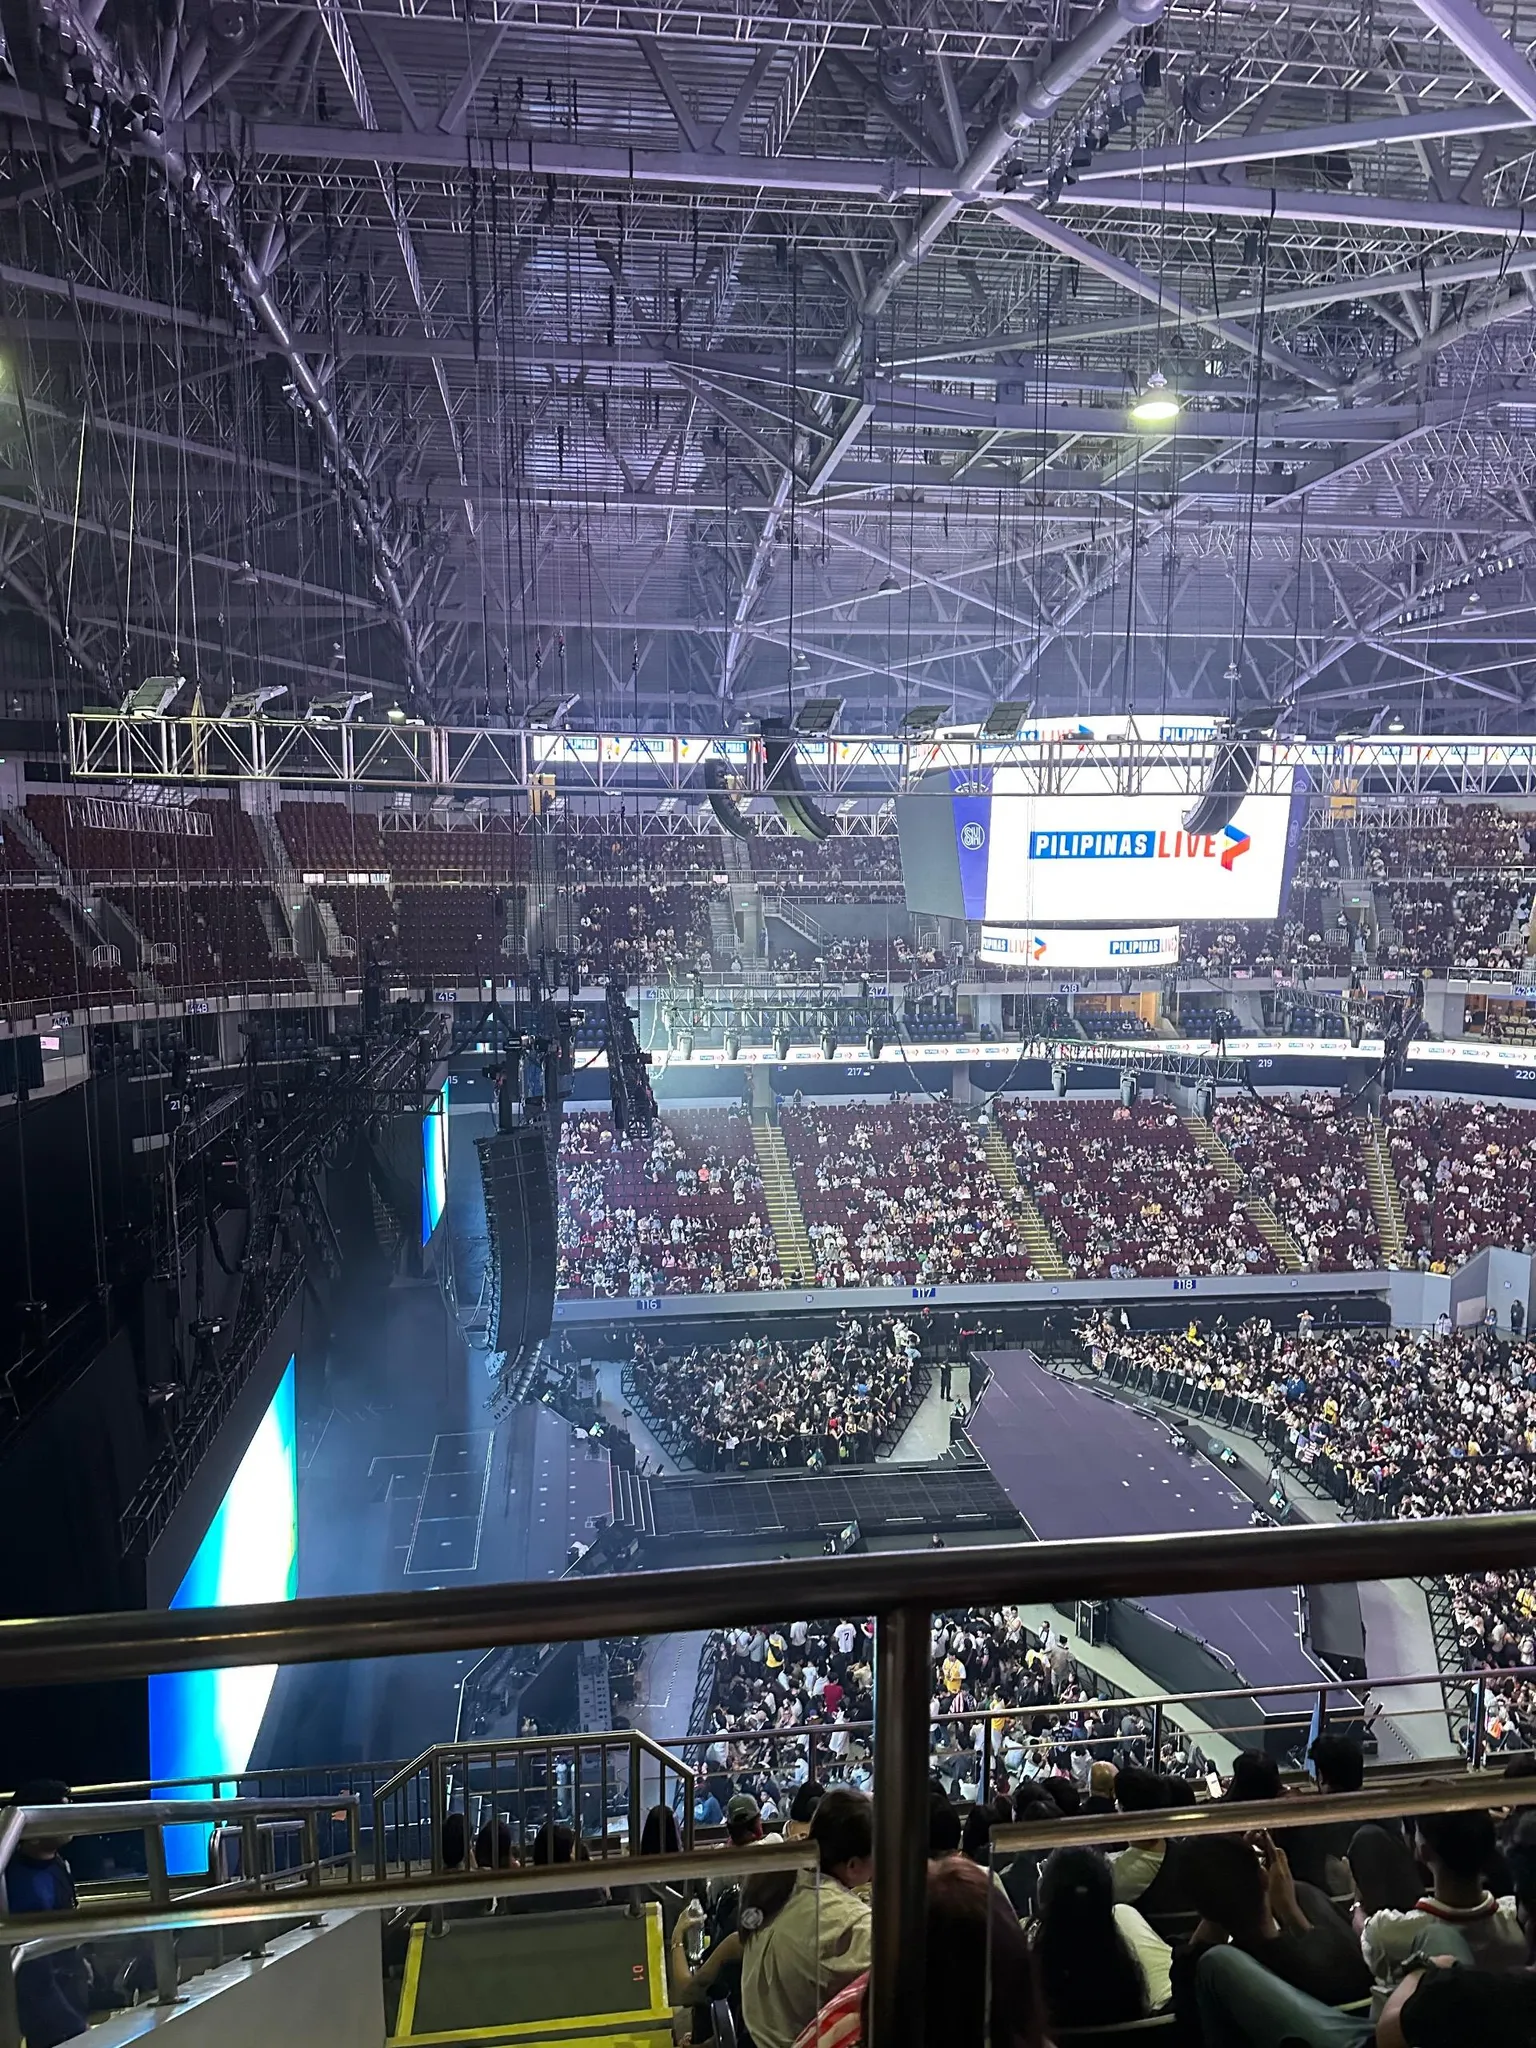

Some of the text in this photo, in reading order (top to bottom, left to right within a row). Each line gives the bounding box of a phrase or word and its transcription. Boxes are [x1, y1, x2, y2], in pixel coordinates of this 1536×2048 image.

[1035, 831, 1216, 858] PILIPINAS LIVE
[1112, 940, 1159, 953] PILIPINAS
[438, 992, 455, 1001] 415
[1258, 1059, 1273, 1068] 219
[847, 1068, 862, 1076] 217
[1515, 1070, 1536, 1080] 220
[1177, 1280, 1193, 1289] 118
[916, 1288, 932, 1298] 117
[640, 1299, 657, 1309] 116
